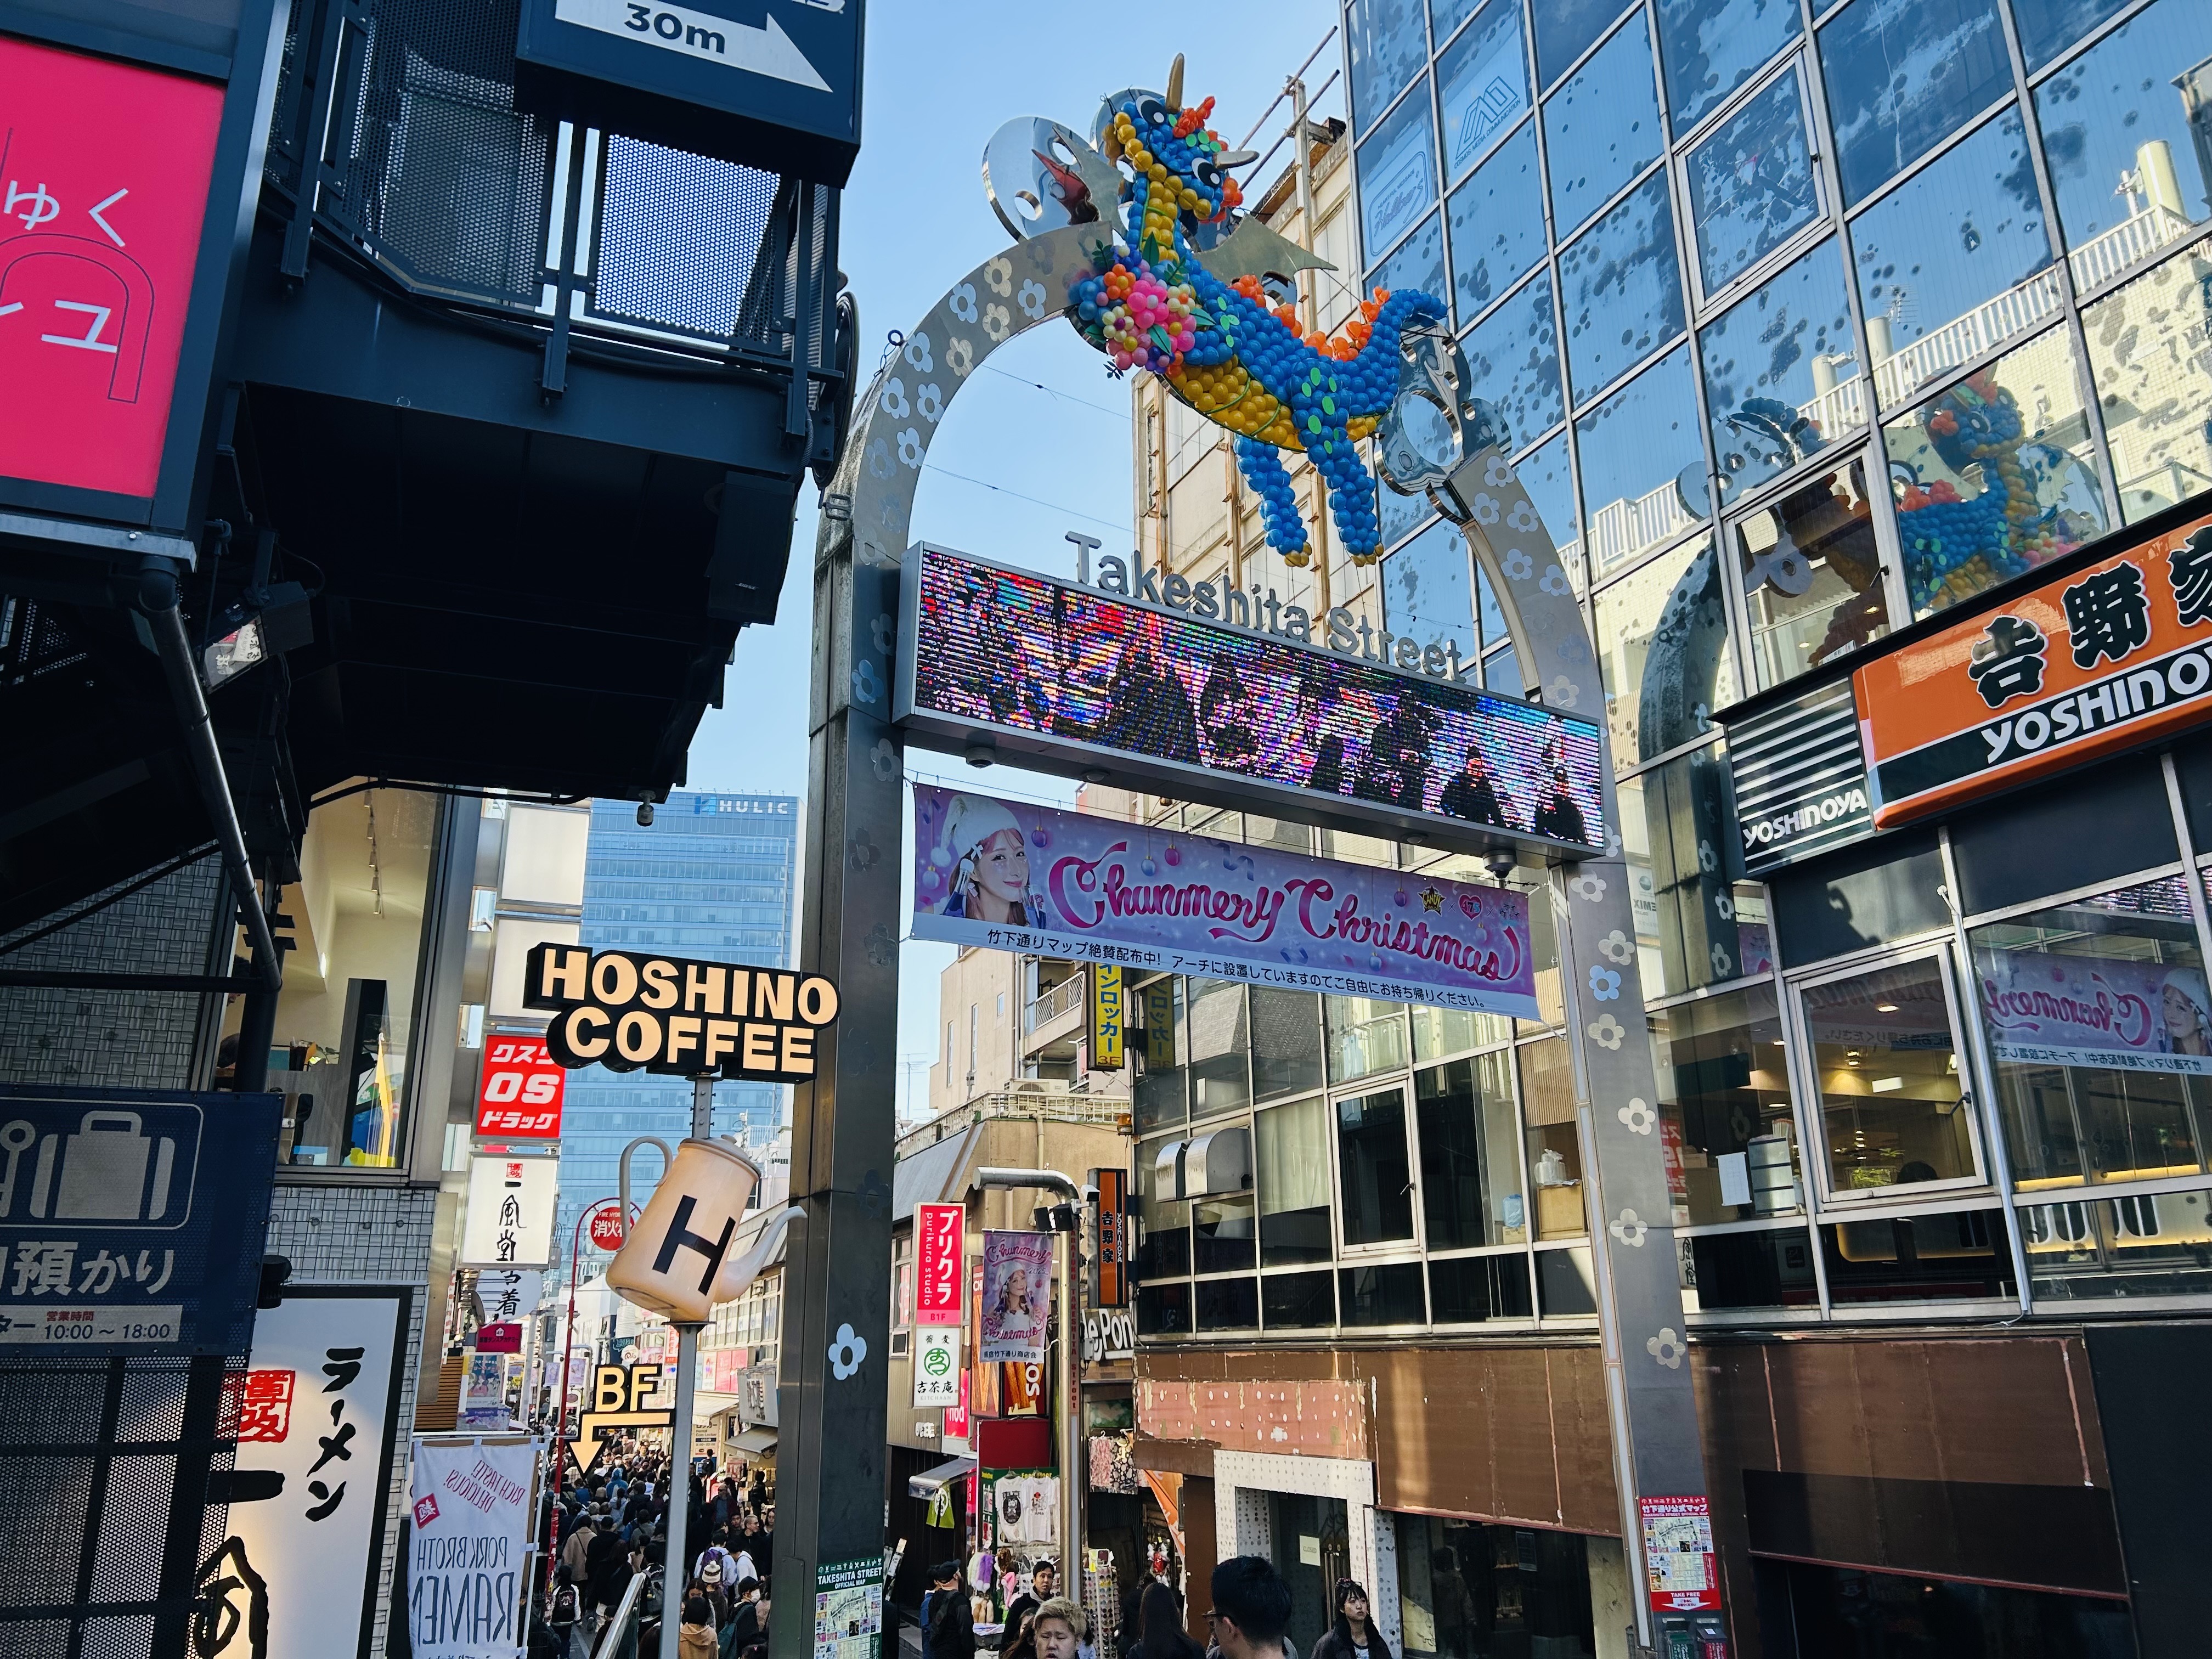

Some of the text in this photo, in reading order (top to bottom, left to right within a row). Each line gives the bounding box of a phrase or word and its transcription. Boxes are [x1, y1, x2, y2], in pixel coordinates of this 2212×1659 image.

[624, 3, 725, 54] 30m
[1065, 531, 1468, 684] Takeshita Street
[1981, 646, 2212, 764] YOSHINO
[719, 800, 788, 814] HULIC
[1742, 788, 1867, 849] YOSHINOYA
[1423, 891, 1441, 906] CANDY
[1462, 900, 1481, 913] 475
[1284, 879, 1521, 982] Christmas
[541, 948, 838, 1025] HOSHINO
[988, 929, 1485, 1008] 竹下通りマップ絶賛配布中! アーチに設置していますのでご自由にお持ち帰りください。
[565, 1006, 815, 1074] COFFEE
[1098, 1056, 1121, 1065] 3F
[484, 1072, 560, 1104] OS
[481, 1110, 558, 1130] ドラッグ
[652, 1194, 736, 1296] H
[924, 1212, 933, 1306] purikura studio
[937, 1209, 958, 1305] プリクラ
[1102, 1210, 1114, 1263] 吉野家
[0, 1242, 174, 1296] 預かり
[44, 1324, 93, 1340] 10:00
[123, 1324, 170, 1339] 18:00
[46, 1311, 94, 1322] 営業時間
[930, 1313, 946, 1321] B1F
[595, 1366, 658, 1412] BF
[917, 1380, 953, 1393] 吉茶庵
[306, 1347, 365, 1522] ラーメン
[817, 1567, 882, 1585] TAKESHITA STREET
[834, 1581, 855, 1589] OFFICIAL
